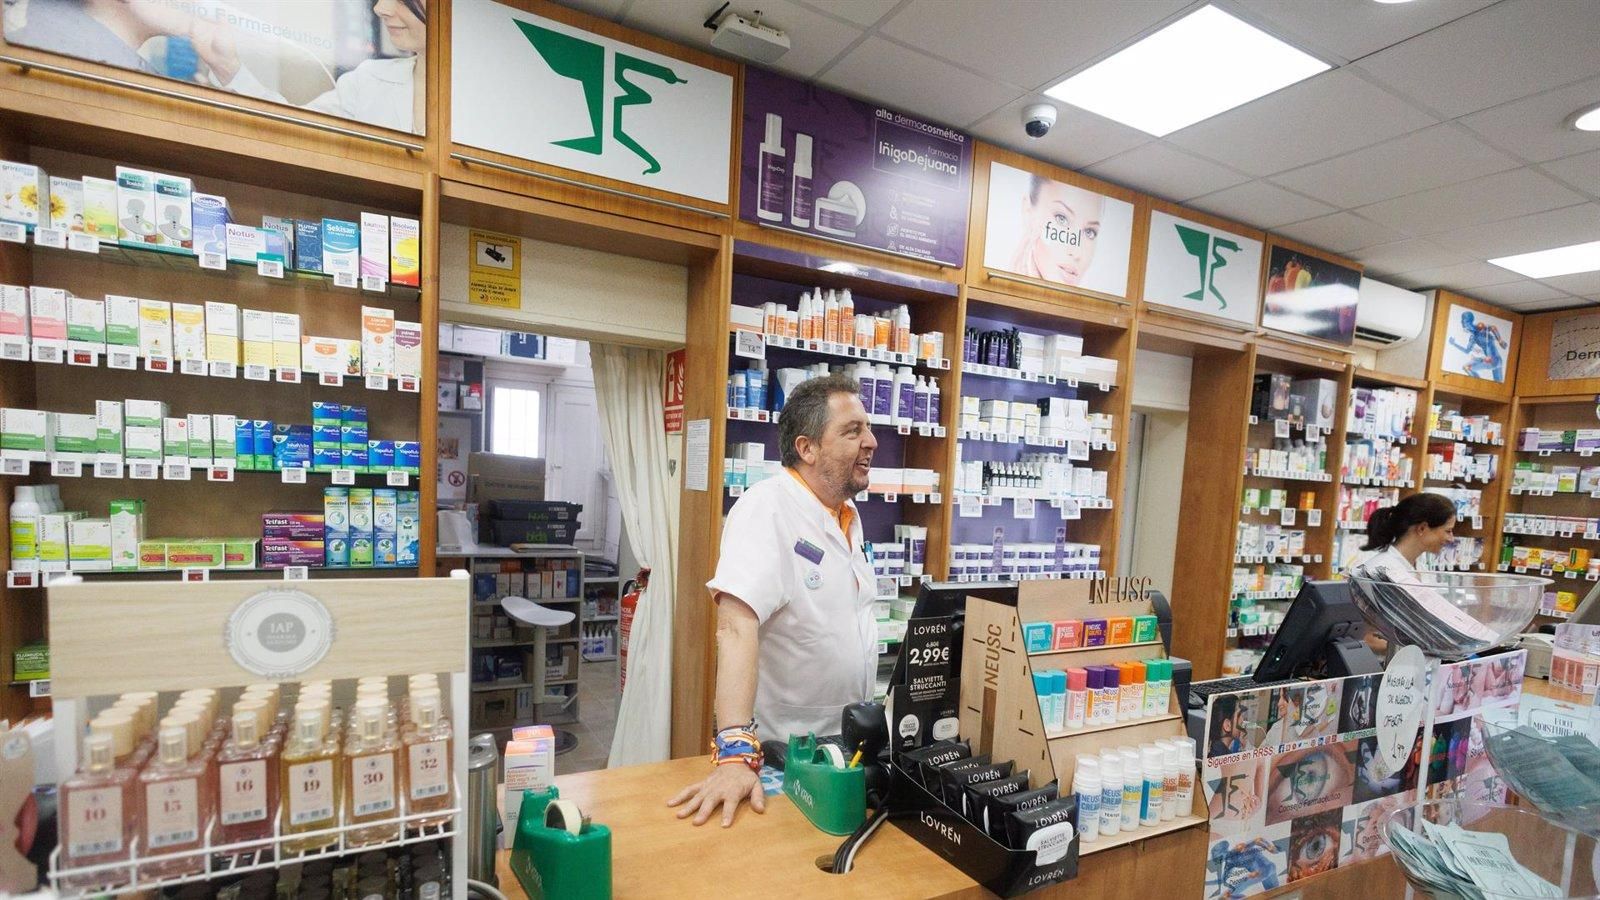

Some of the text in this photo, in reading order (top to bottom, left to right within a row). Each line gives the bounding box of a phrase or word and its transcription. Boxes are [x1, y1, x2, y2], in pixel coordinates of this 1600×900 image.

[876, 108, 965, 143] alta dermocosmética
[879, 140, 958, 176] IñigoDejuana
[928, 145, 959, 162] farmacia
[228, 227, 256, 242] Notus
[263, 221, 289, 236] Notus
[325, 223, 357, 238] Sekisan
[1045, 221, 1082, 247] facial
[265, 518, 289, 526] Telfast
[914, 624, 947, 636] LOVRÉN
[909, 647, 950, 666] 2,99€
[984, 624, 1003, 687] NEUSC
[909, 681, 947, 692] STRUCCANTI
[912, 675, 945, 685] SALVIETTE
[927, 750, 961, 766] LOVRÉN
[1242, 753, 1251, 761] en
[1252, 746, 1274, 759] RRSS
[420, 757, 438, 771] 32
[363, 771, 384, 785] 30
[967, 770, 1001, 784] LOVRÉN
[234, 779, 254, 793] 16
[303, 779, 321, 794] 19
[1102, 786, 1122, 799] NEUSC
[162, 799, 182, 814] 15
[1015, 795, 1048, 813] LOVRÉN
[1081, 793, 1101, 805] NEUSC
[82, 805, 107, 822] 10
[1034, 809, 1068, 828] LOVRÉN
[920, 810, 961, 846] LOVRÉN
[1028, 868, 1065, 887] LOVRÉN
